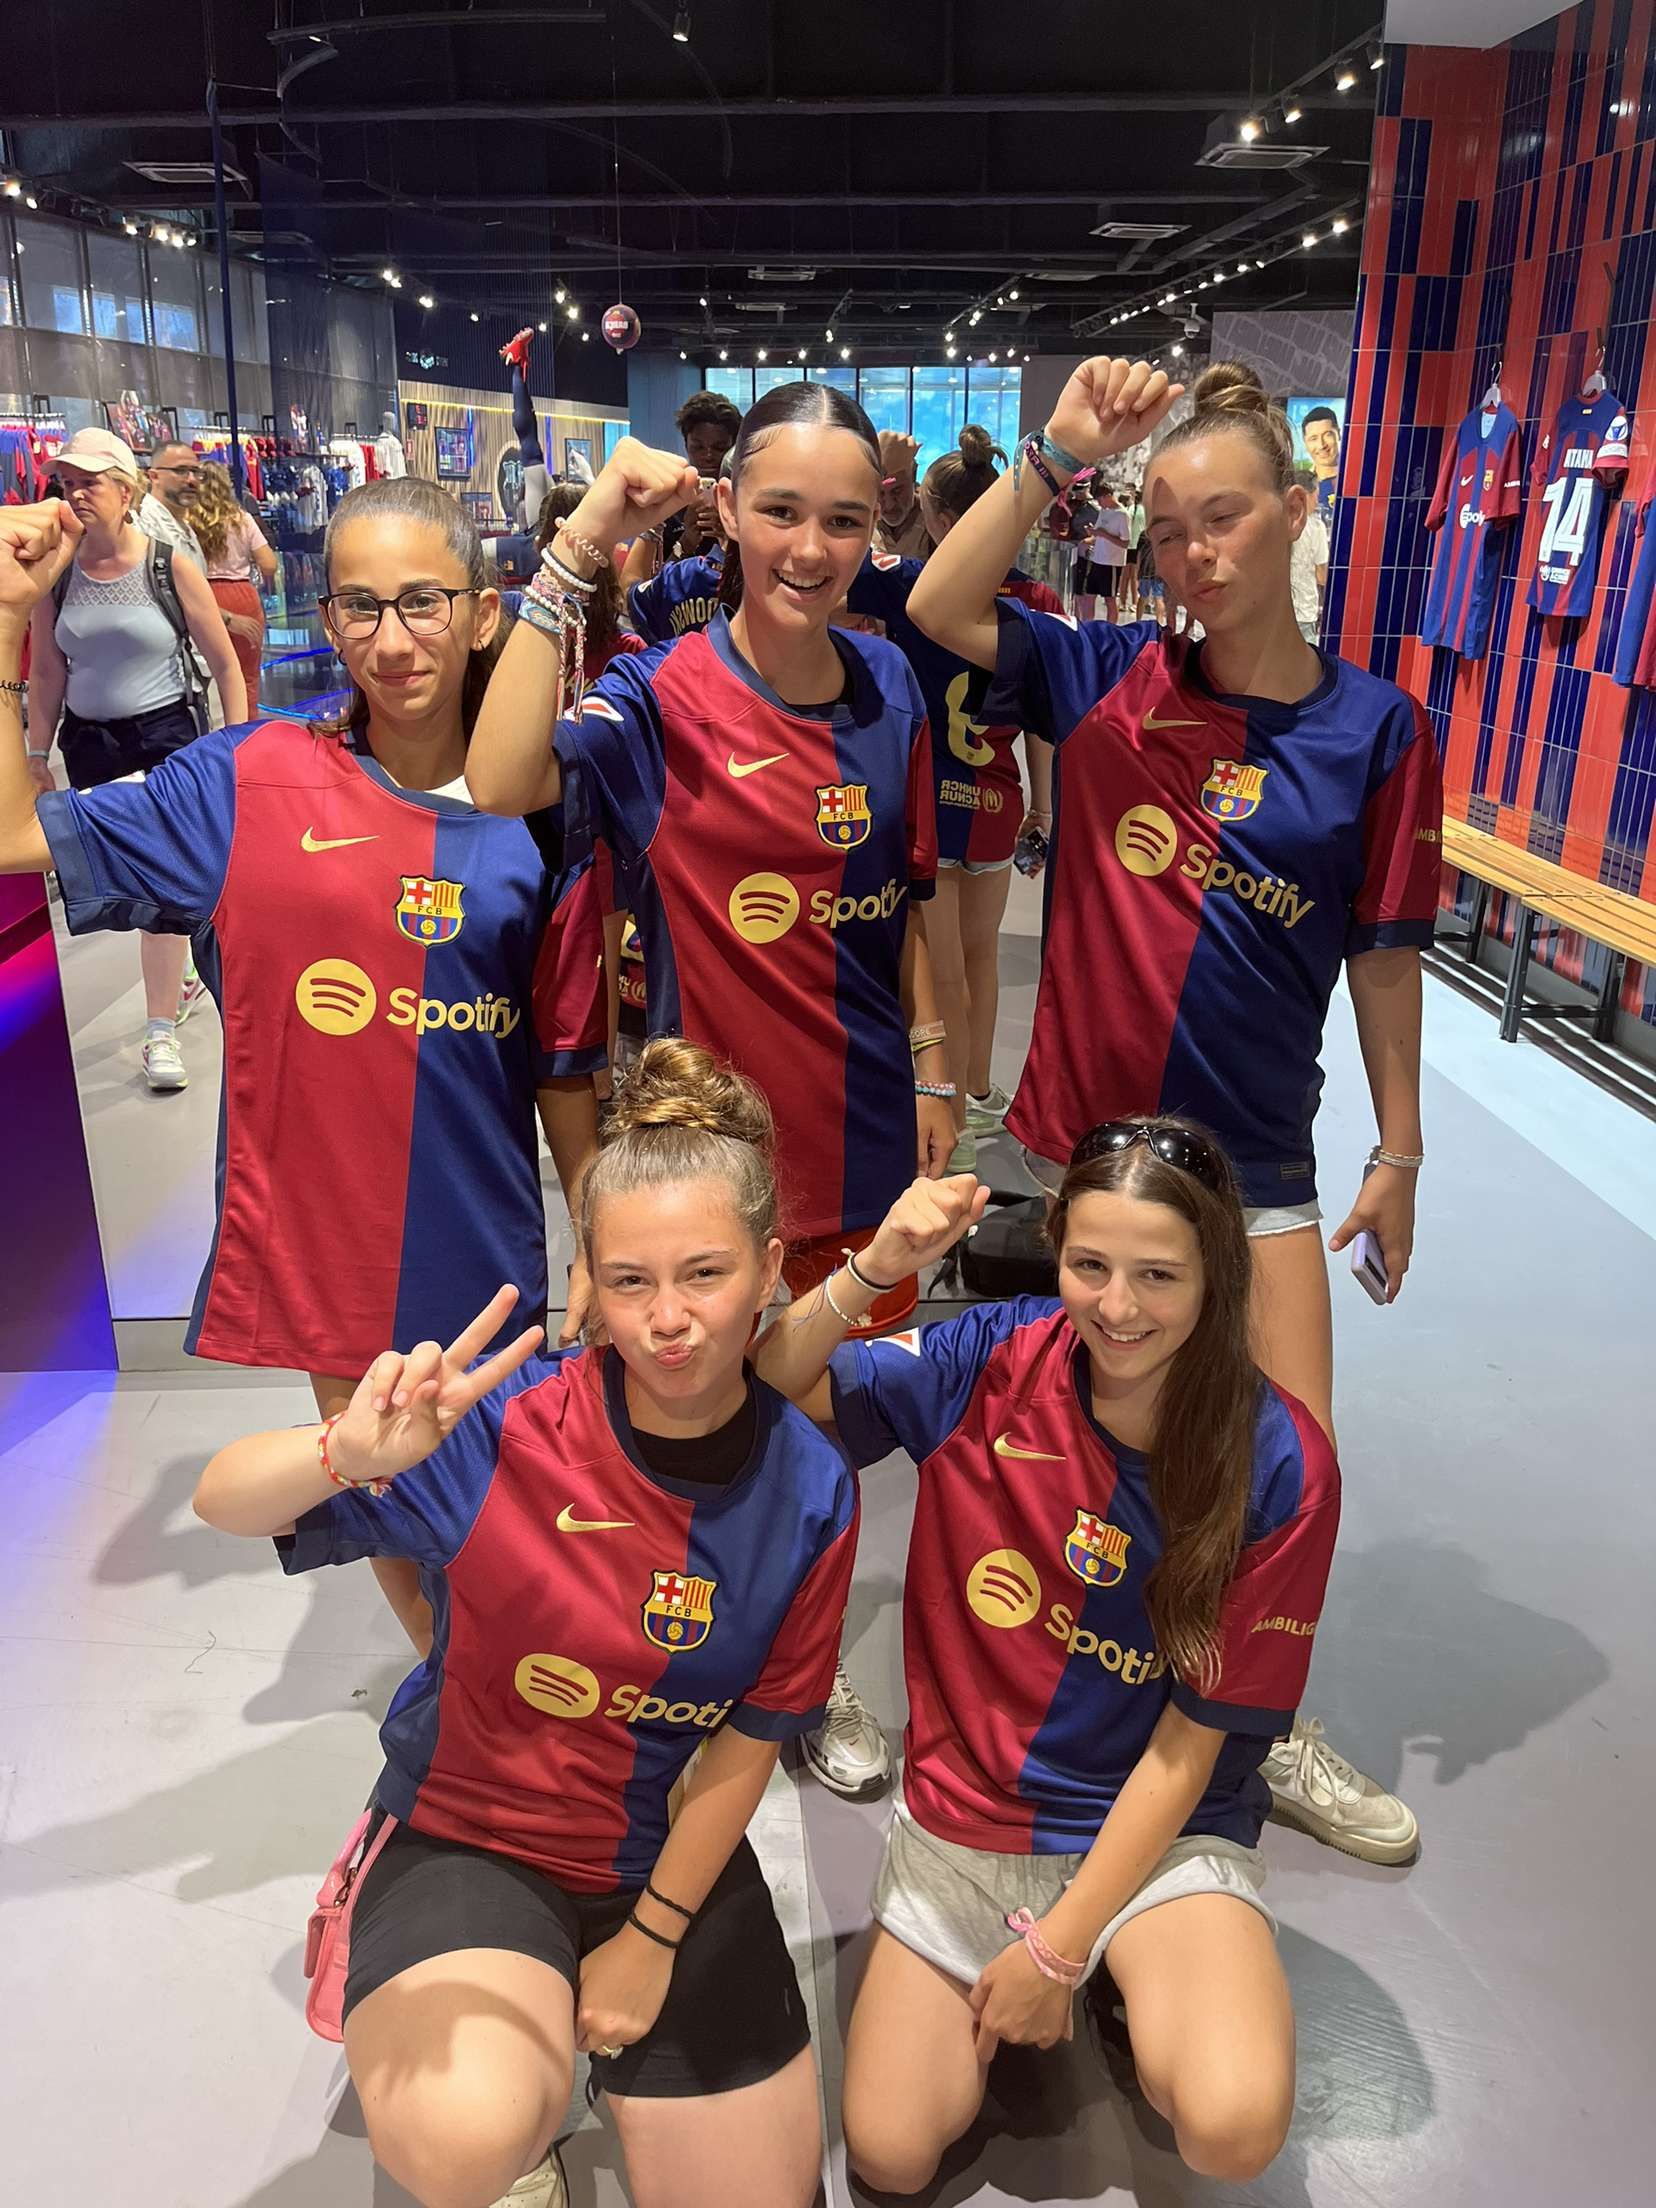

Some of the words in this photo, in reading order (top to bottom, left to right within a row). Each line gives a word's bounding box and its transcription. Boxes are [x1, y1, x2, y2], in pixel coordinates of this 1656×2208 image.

[1538, 476, 1595, 567] 14
[808, 878, 908, 929] Spotfy
[1180, 843, 1316, 929] Spotify
[417, 905, 442, 916] FCB
[385, 986, 521, 1039] Spotify
[665, 1604, 692, 1618] FCB
[1250, 1616, 1317, 1636] AMBILIG
[604, 1684, 734, 1728] Spoti
